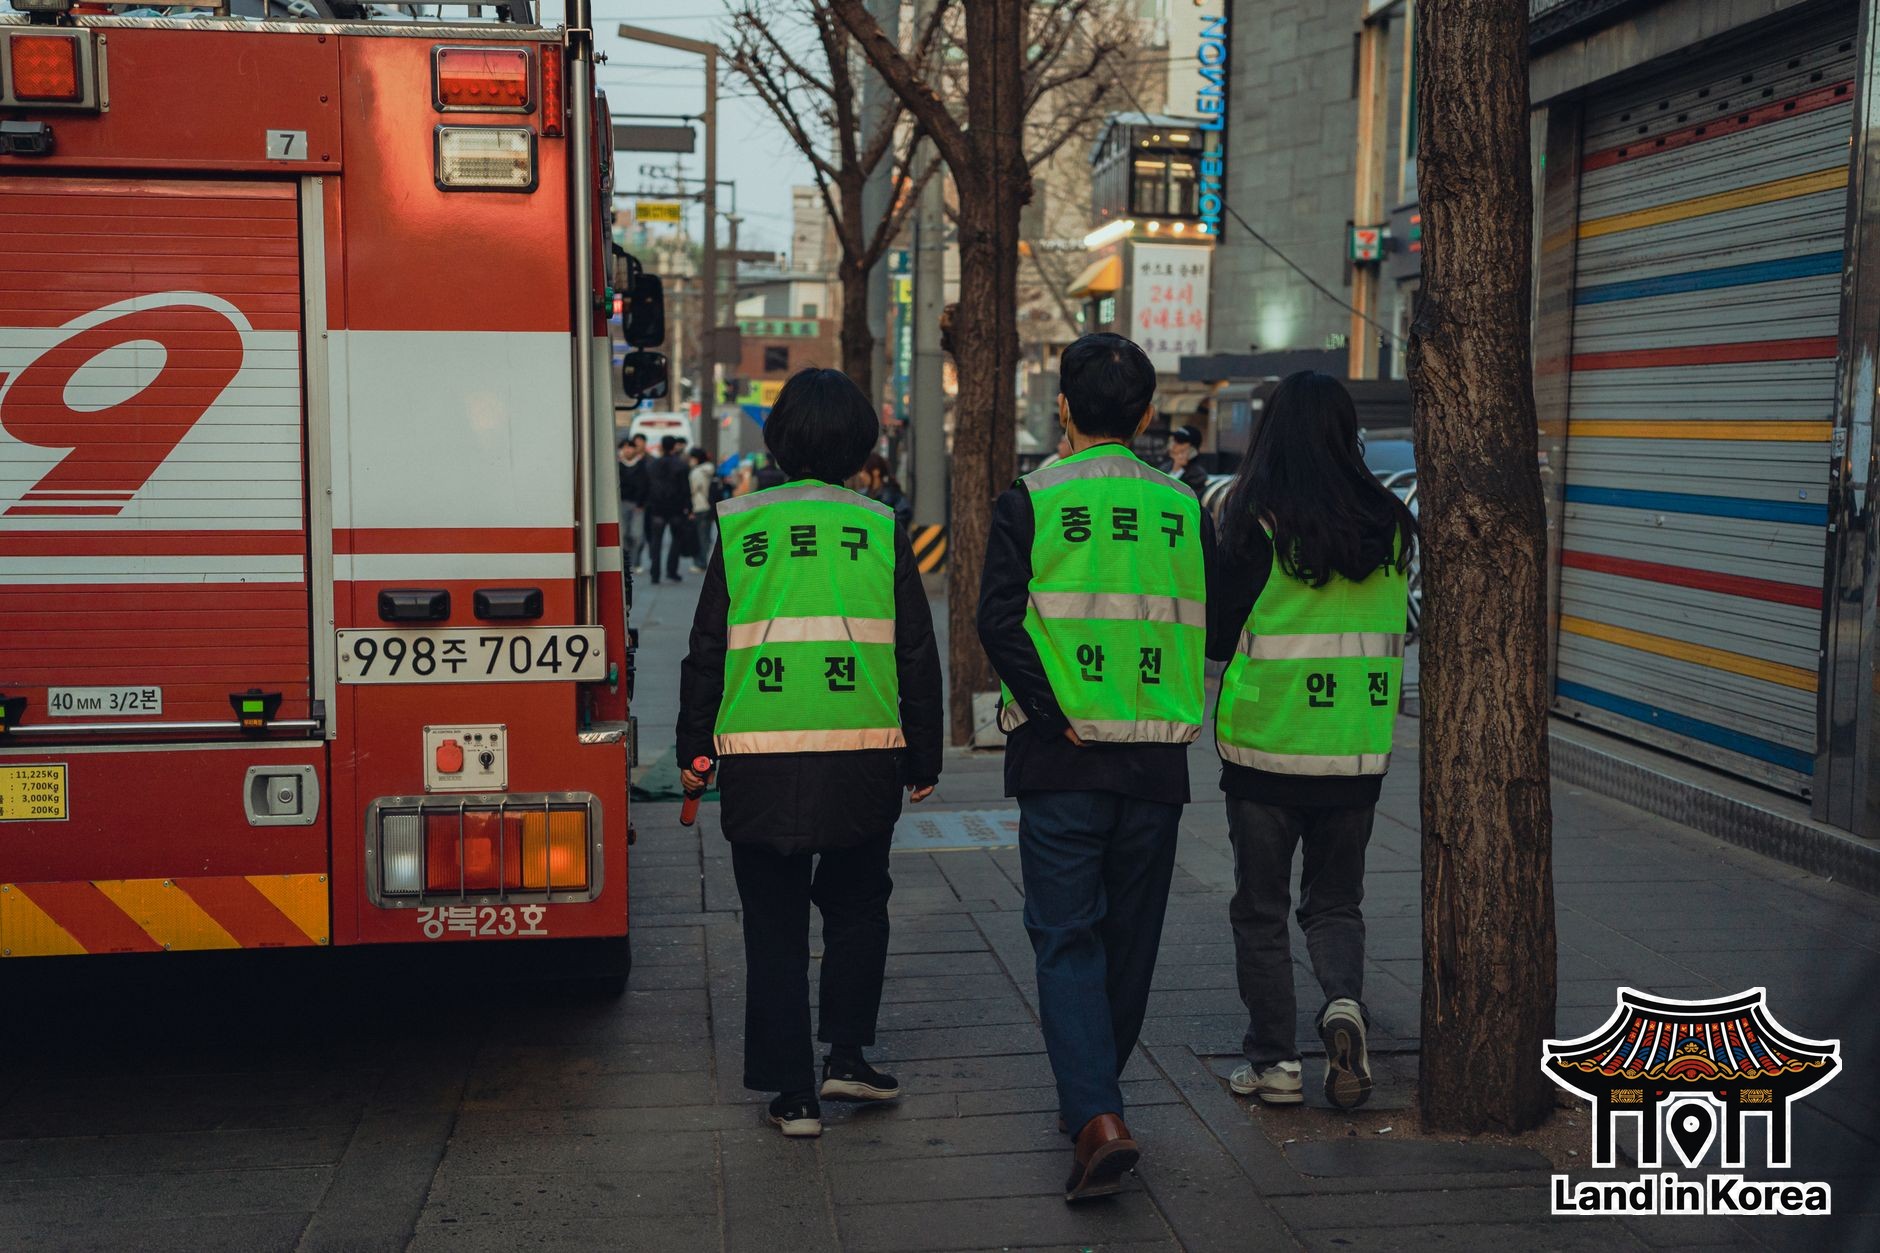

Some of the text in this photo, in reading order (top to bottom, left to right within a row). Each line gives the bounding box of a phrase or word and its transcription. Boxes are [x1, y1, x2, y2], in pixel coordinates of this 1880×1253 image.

[1197, 15, 1227, 236] HOTEL LEMON
[279, 133, 296, 156] 7
[0, 304, 244, 516] 9
[1061, 506, 1184, 548] 종로구
[742, 524, 869, 567] 종로구
[353, 634, 589, 676] 998주 7049
[1076, 644, 1162, 684] 안전
[755, 656, 856, 692] 안전
[1306, 672, 1388, 707] 안전
[51, 689, 158, 712] 40 MM 3/2본
[22, 782, 59, 792] 7,700Kg
[22, 794, 59, 804] 3,000Kg
[31, 806, 60, 815] 200Kg
[417, 904, 548, 939] 강북23호
